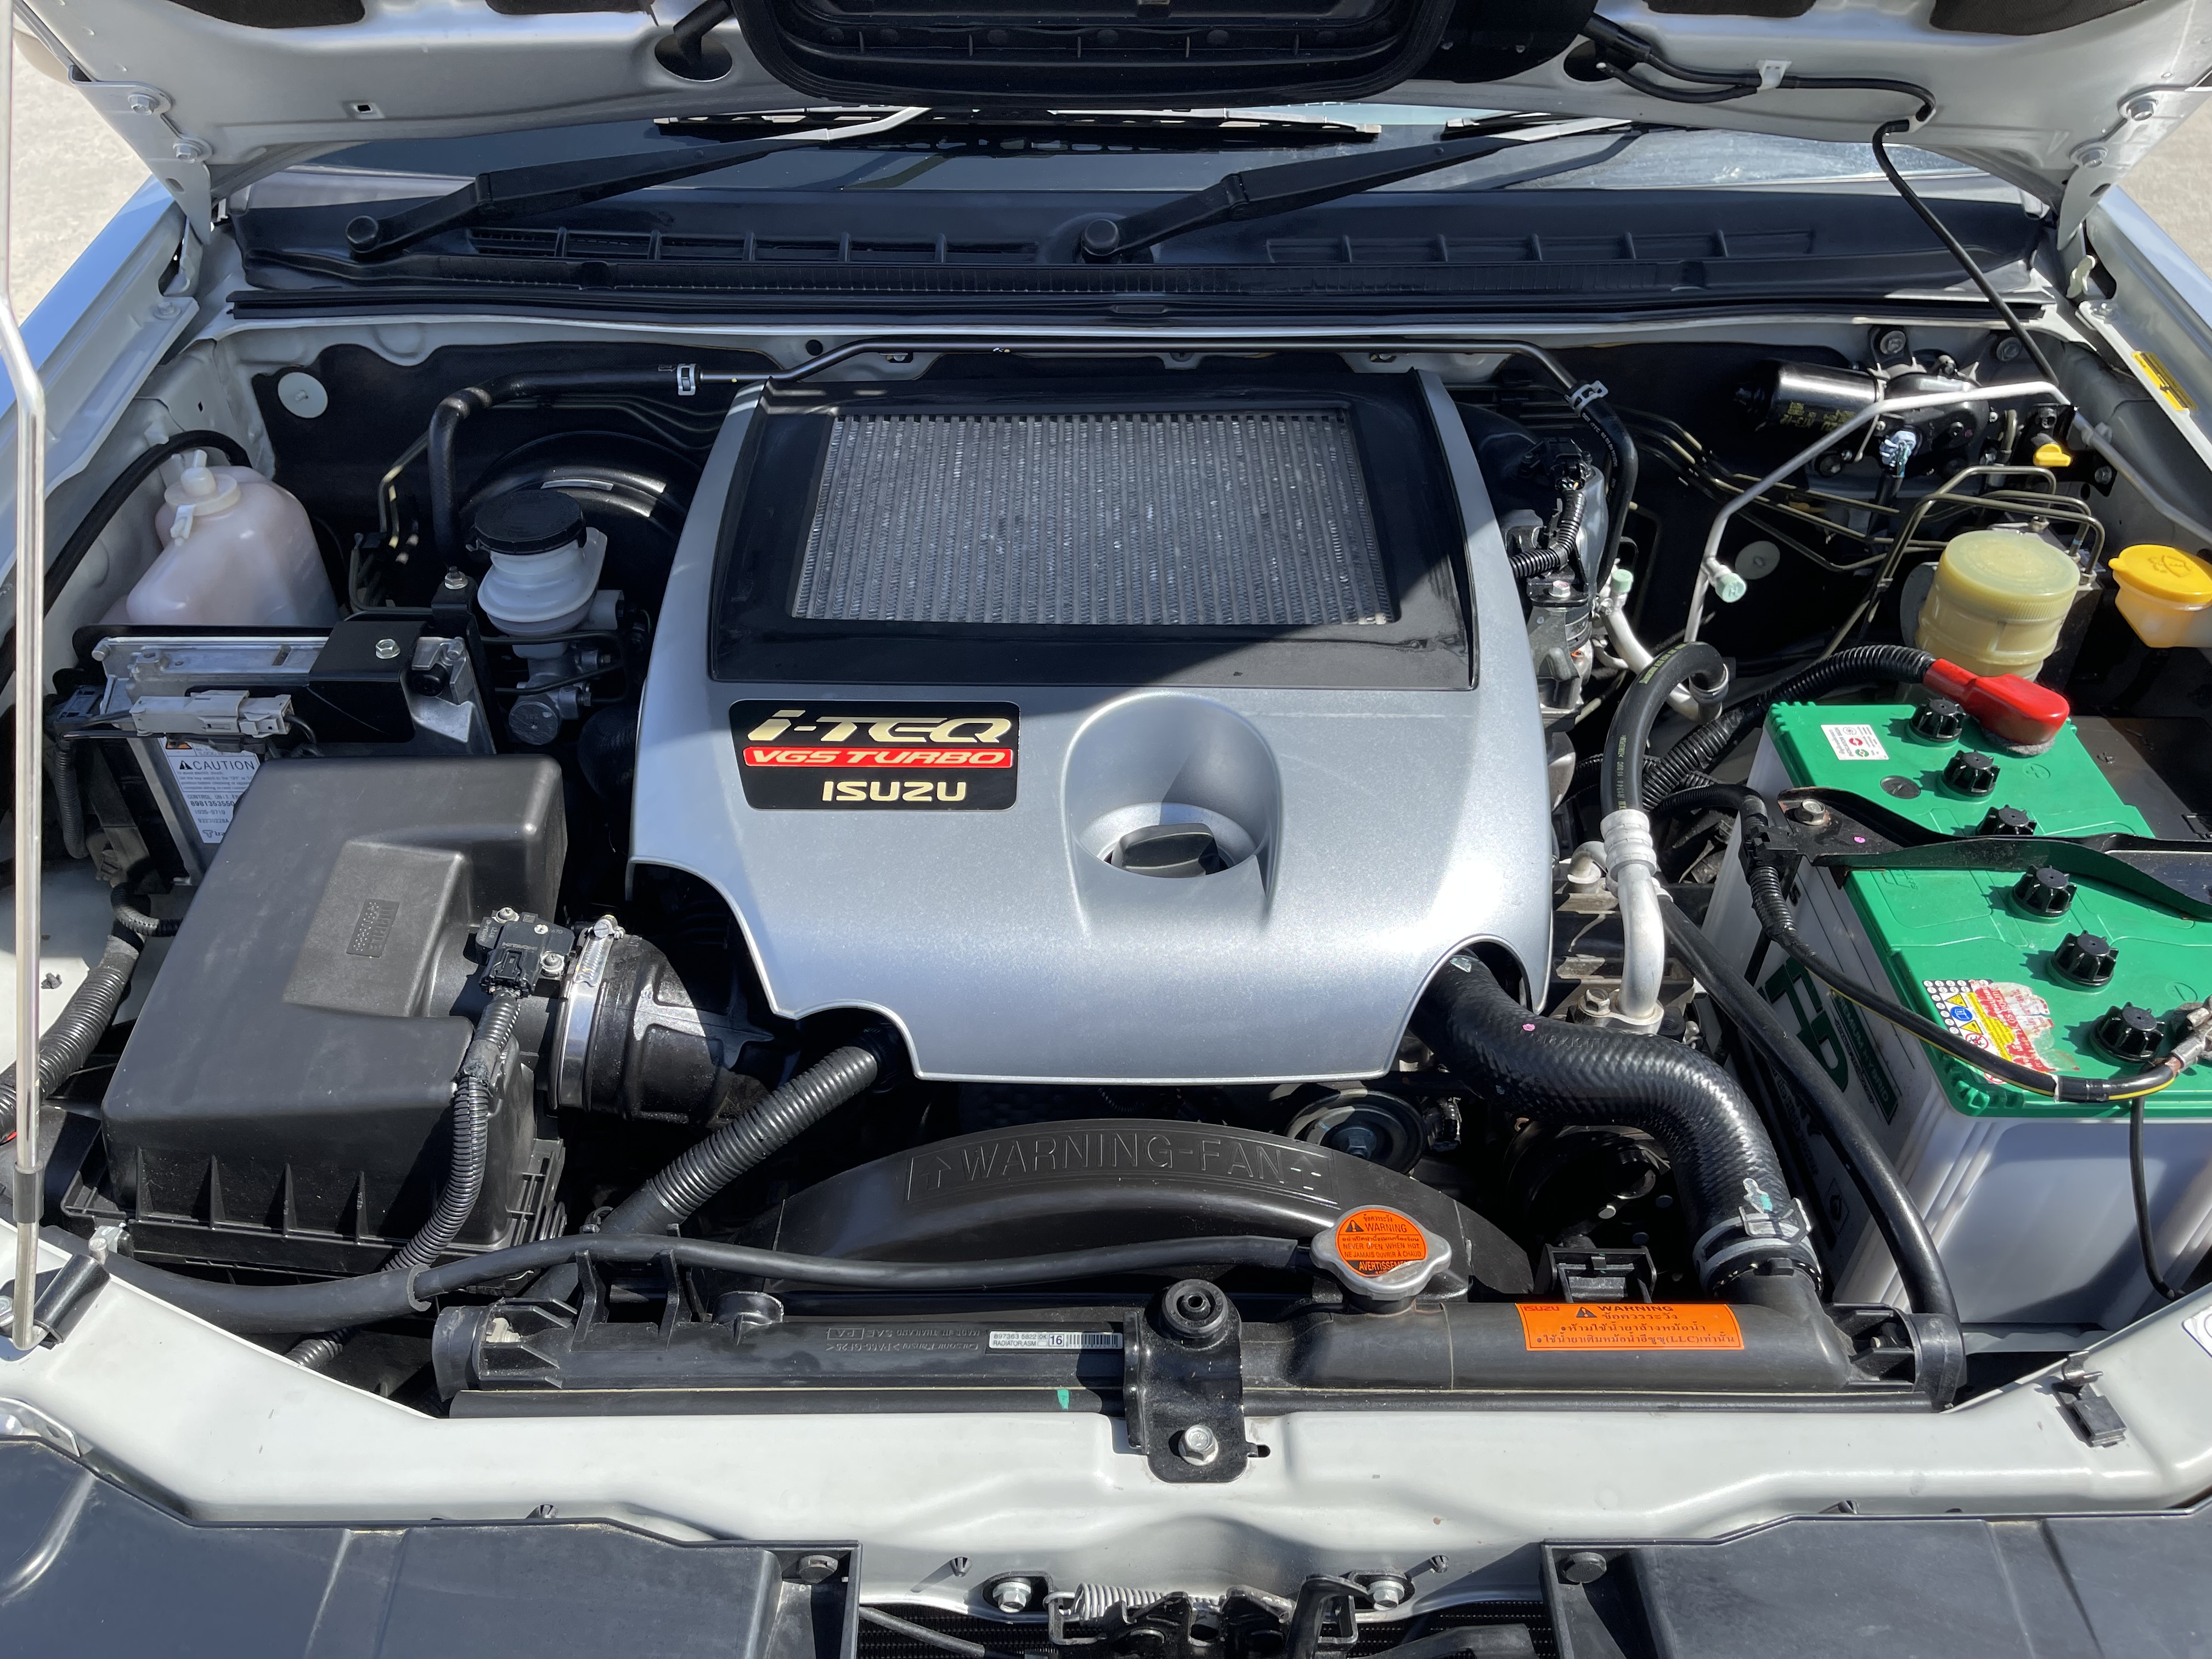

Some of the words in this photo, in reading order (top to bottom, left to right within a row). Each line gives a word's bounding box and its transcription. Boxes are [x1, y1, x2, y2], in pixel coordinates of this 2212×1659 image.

[753, 751, 842, 764] VGS
[847, 751, 1006, 764] TURBO
[193, 760, 255, 770] CAUTION
[822, 781, 967, 802] ISUZU
[1364, 1223, 1407, 1233] WARNING
[1602, 1312, 1679, 1320] ข้อควรระวัง
[1050, 1335, 1063, 1345] 16
